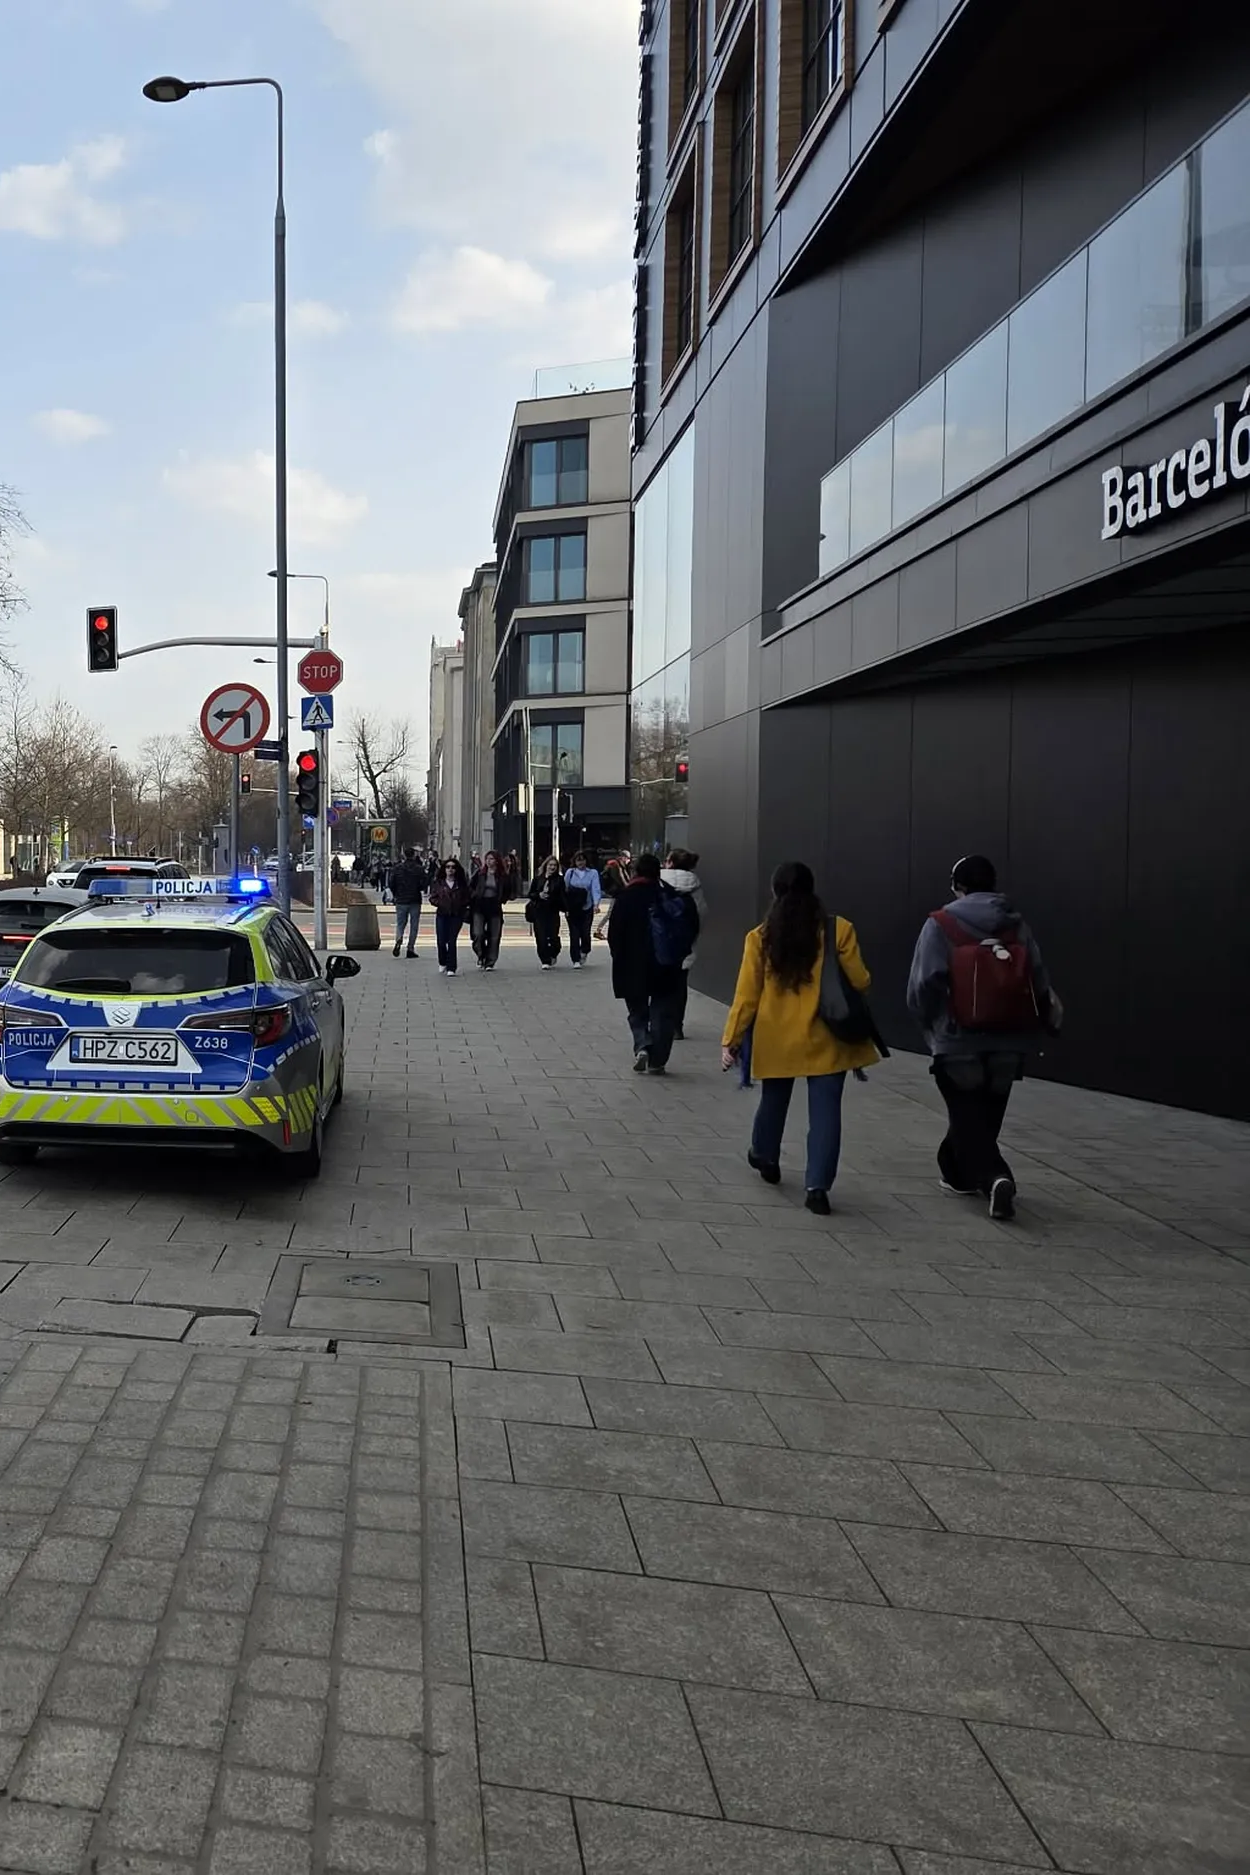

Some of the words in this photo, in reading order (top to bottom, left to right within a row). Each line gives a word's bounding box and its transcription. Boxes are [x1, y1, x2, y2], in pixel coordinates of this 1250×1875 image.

[1101, 384, 1250, 541] Barceló
[304, 665, 337, 679] STOP
[155, 880, 213, 895] POLICJA
[8, 1032, 56, 1046] POLICJA
[194, 1036, 228, 1049] Z638
[83, 1039, 118, 1058] HPZ
[125, 1040, 171, 1060] C562
